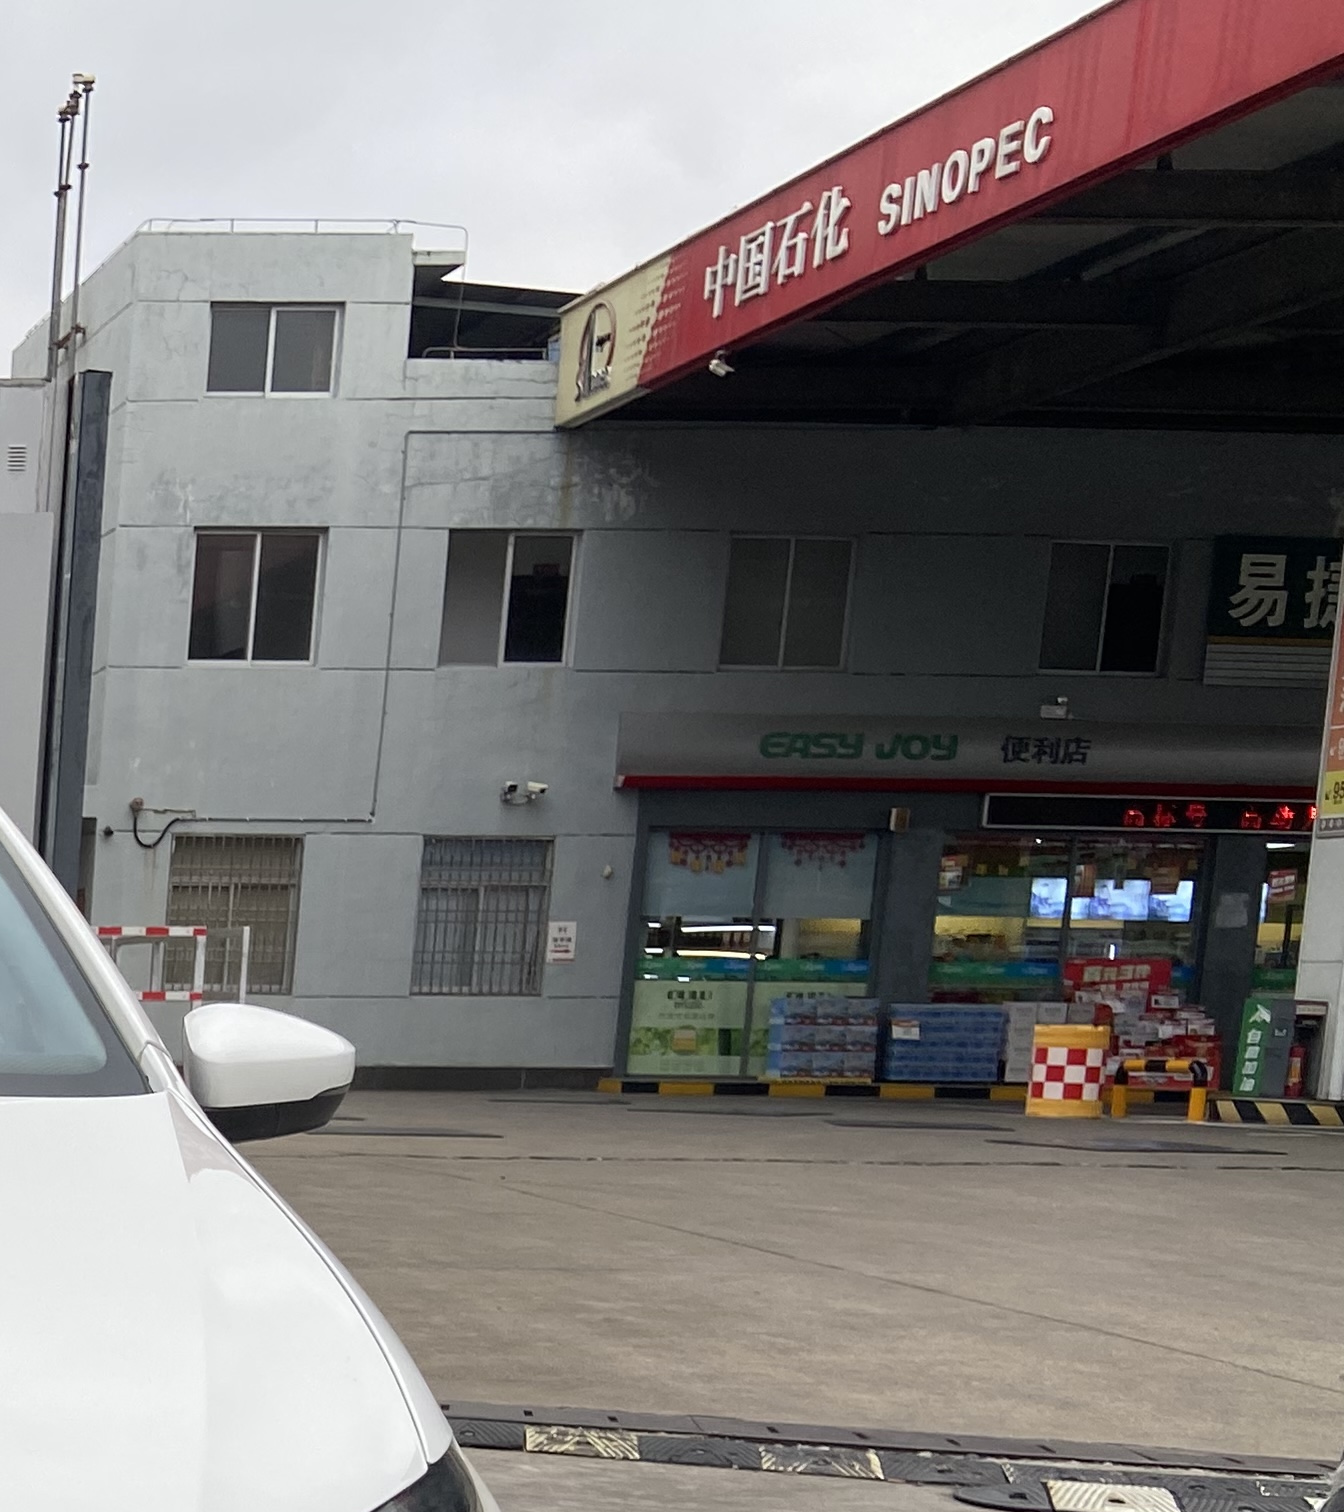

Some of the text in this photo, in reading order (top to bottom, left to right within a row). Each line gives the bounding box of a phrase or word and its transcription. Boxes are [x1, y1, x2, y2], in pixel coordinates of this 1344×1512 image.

[877, 105, 1054, 236] SINOPEC
[704, 186, 852, 319] 中国石化
[759, 731, 959, 761] EASY JOY
[1000, 735, 1092, 765] 便利店
